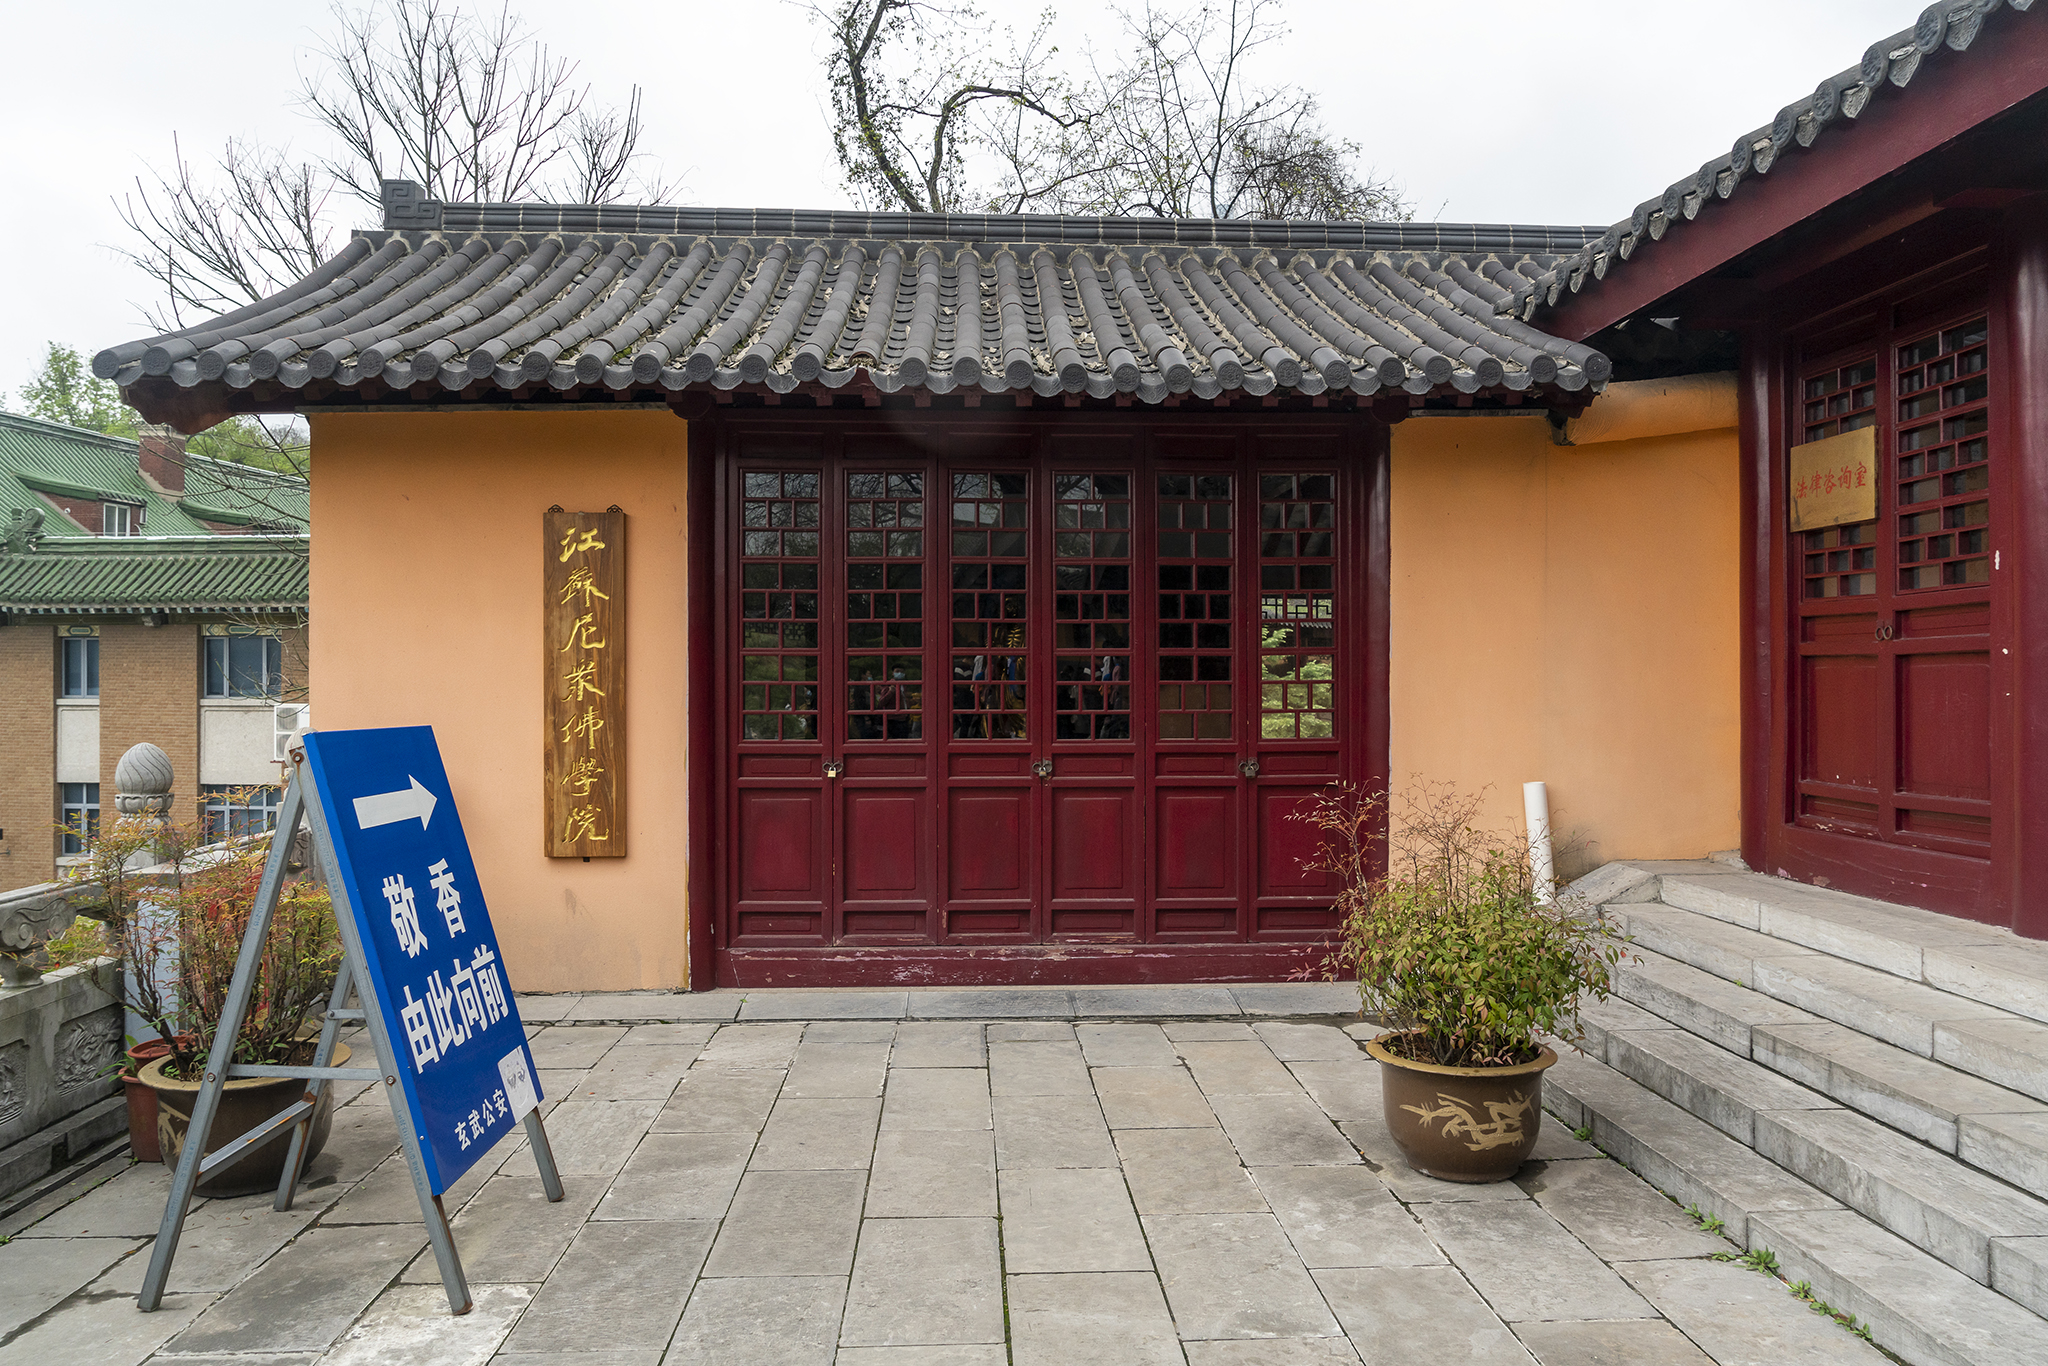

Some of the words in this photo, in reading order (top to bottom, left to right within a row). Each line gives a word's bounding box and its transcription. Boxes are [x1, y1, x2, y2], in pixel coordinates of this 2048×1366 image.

[1796, 461, 1867, 499] 法律咨询室
[382, 857, 466, 959] 敬香
[400, 944, 509, 1075] 由此向前
[454, 1088, 508, 1152] 玄武公安
